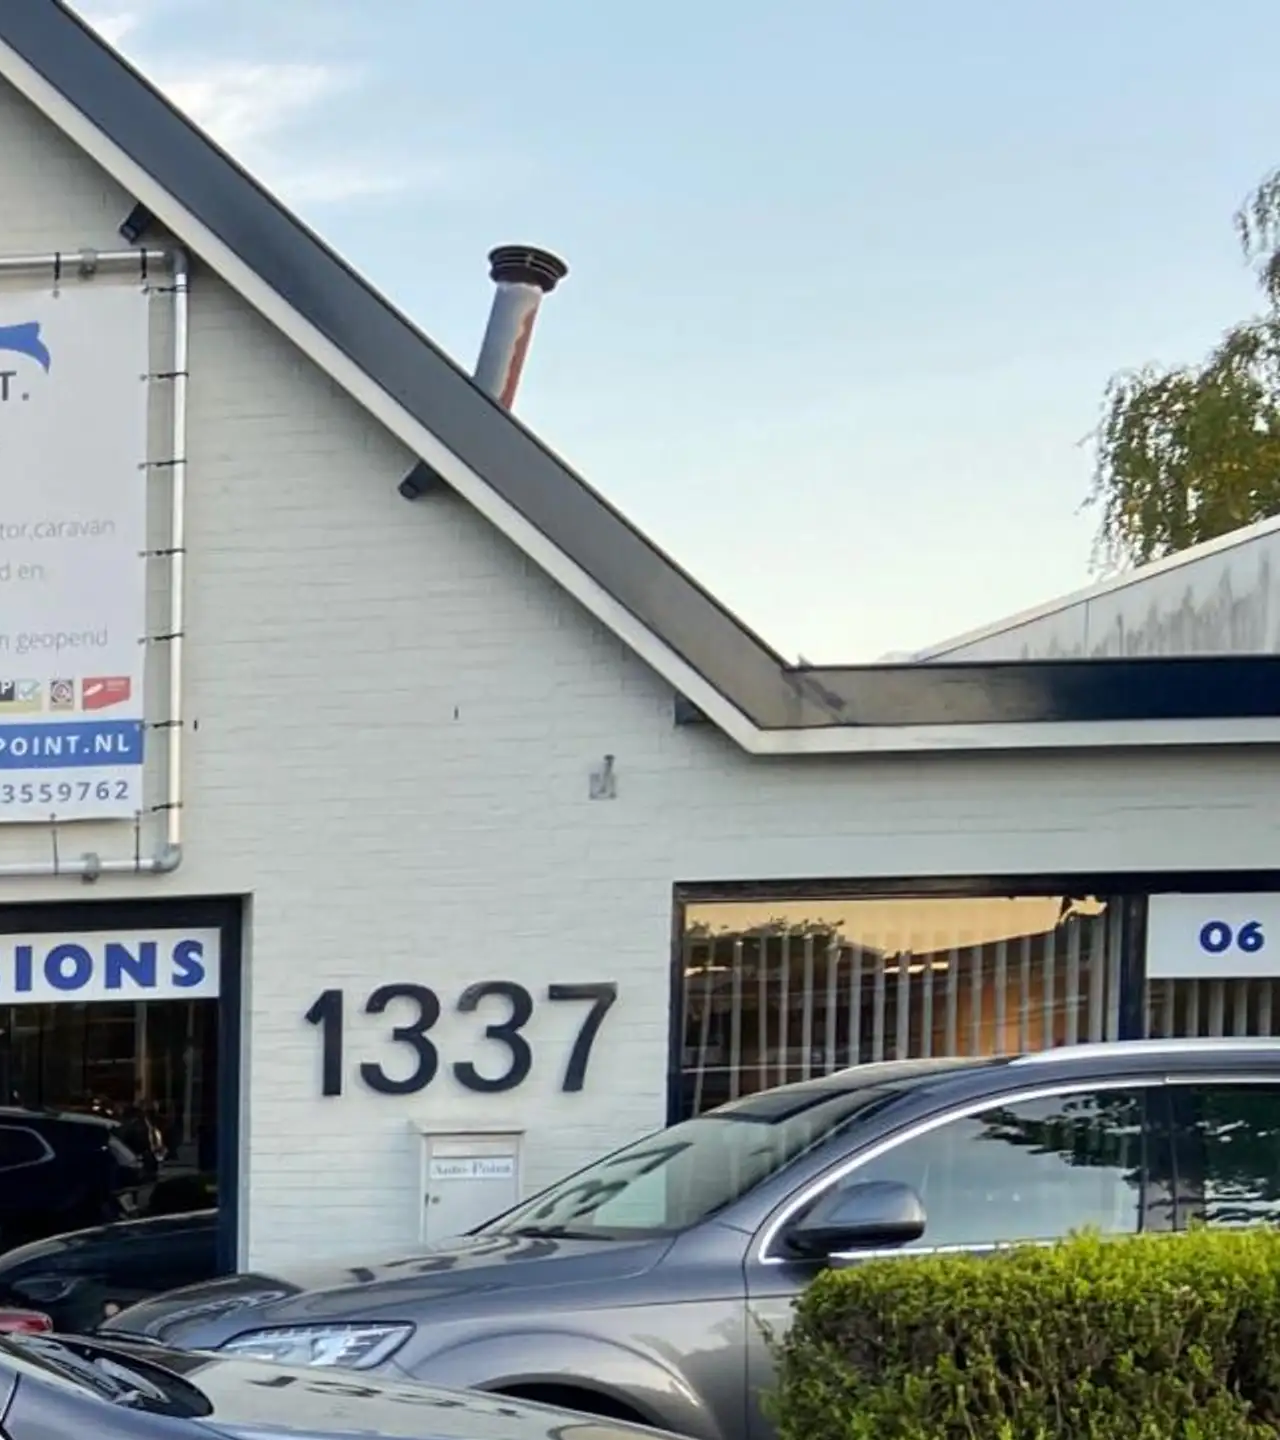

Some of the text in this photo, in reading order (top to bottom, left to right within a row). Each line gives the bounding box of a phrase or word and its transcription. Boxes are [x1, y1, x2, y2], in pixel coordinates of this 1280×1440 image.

[17, 565, 45, 580] en
[15, 625, 108, 655] geopend
[1199, 920, 1265, 953] 06
[304, 980, 619, 1098] 1337
